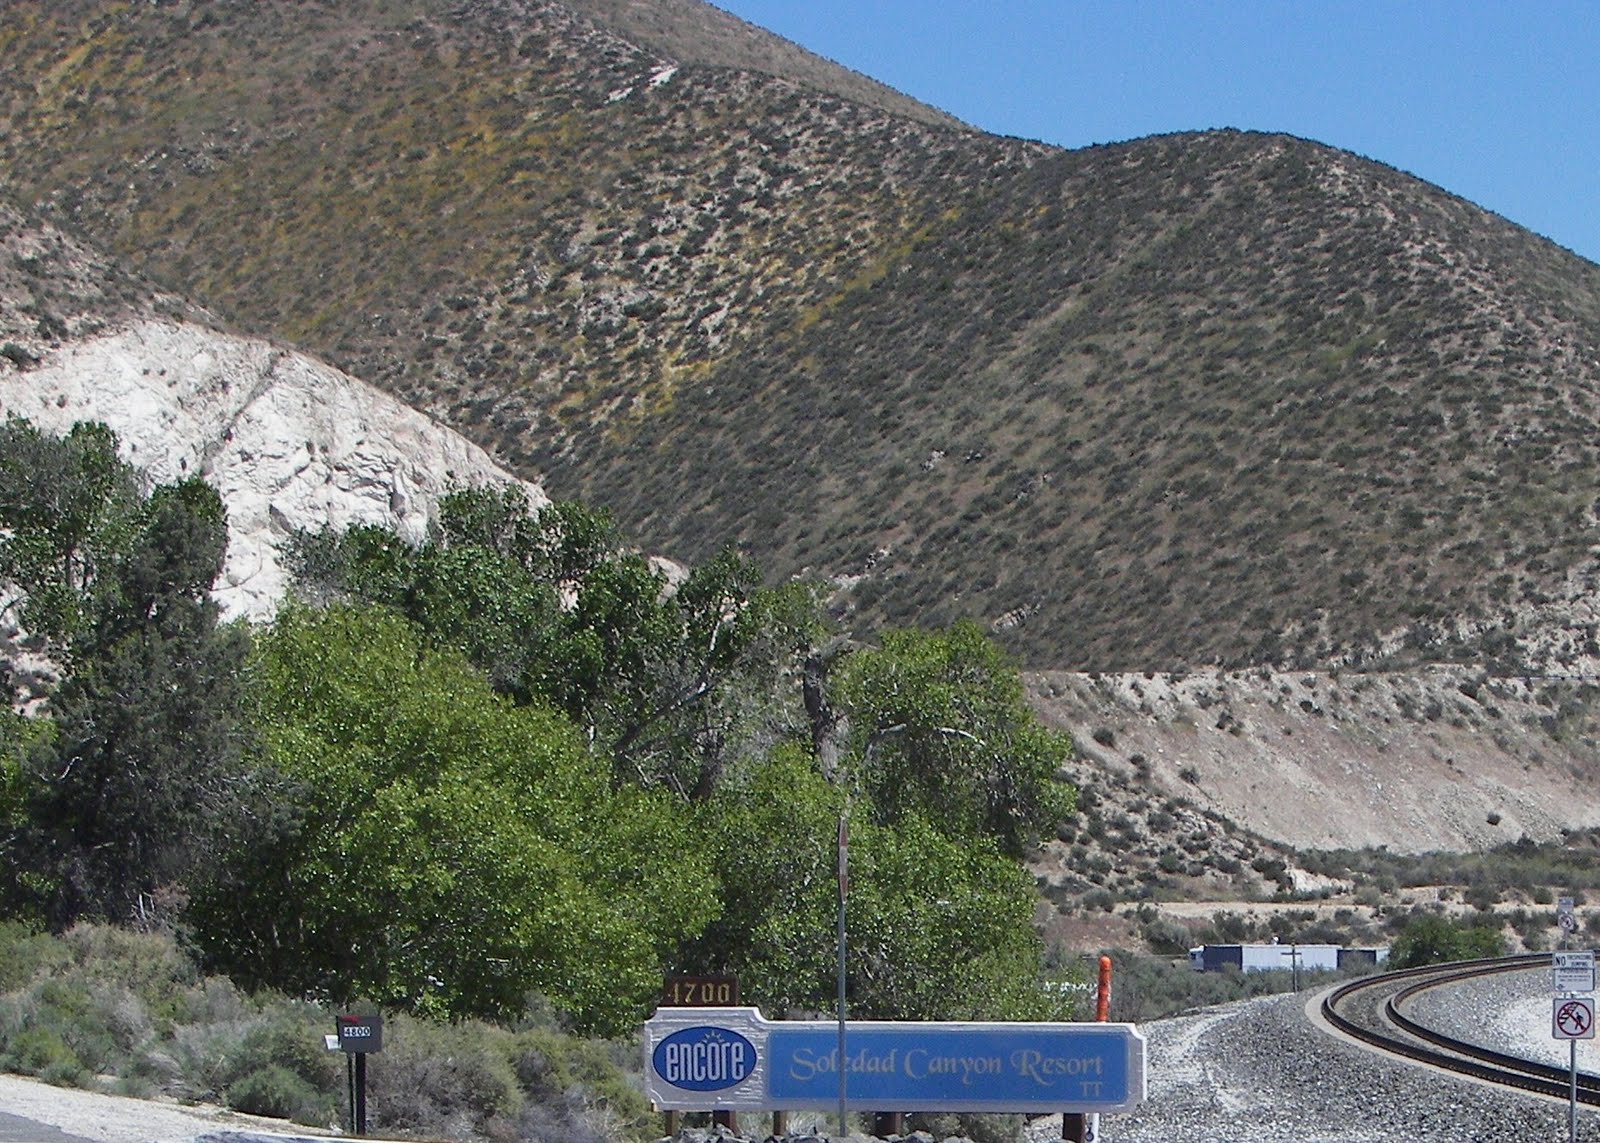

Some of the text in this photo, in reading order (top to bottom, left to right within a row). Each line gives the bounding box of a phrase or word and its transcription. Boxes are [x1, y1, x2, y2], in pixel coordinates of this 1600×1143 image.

[344, 1027, 370, 1036] 4800
[666, 1042, 745, 1081] encore
[904, 1049, 1001, 1086] Canyon
[1010, 1050, 1103, 1087] Resort
[1080, 1081, 1103, 1097] TT
